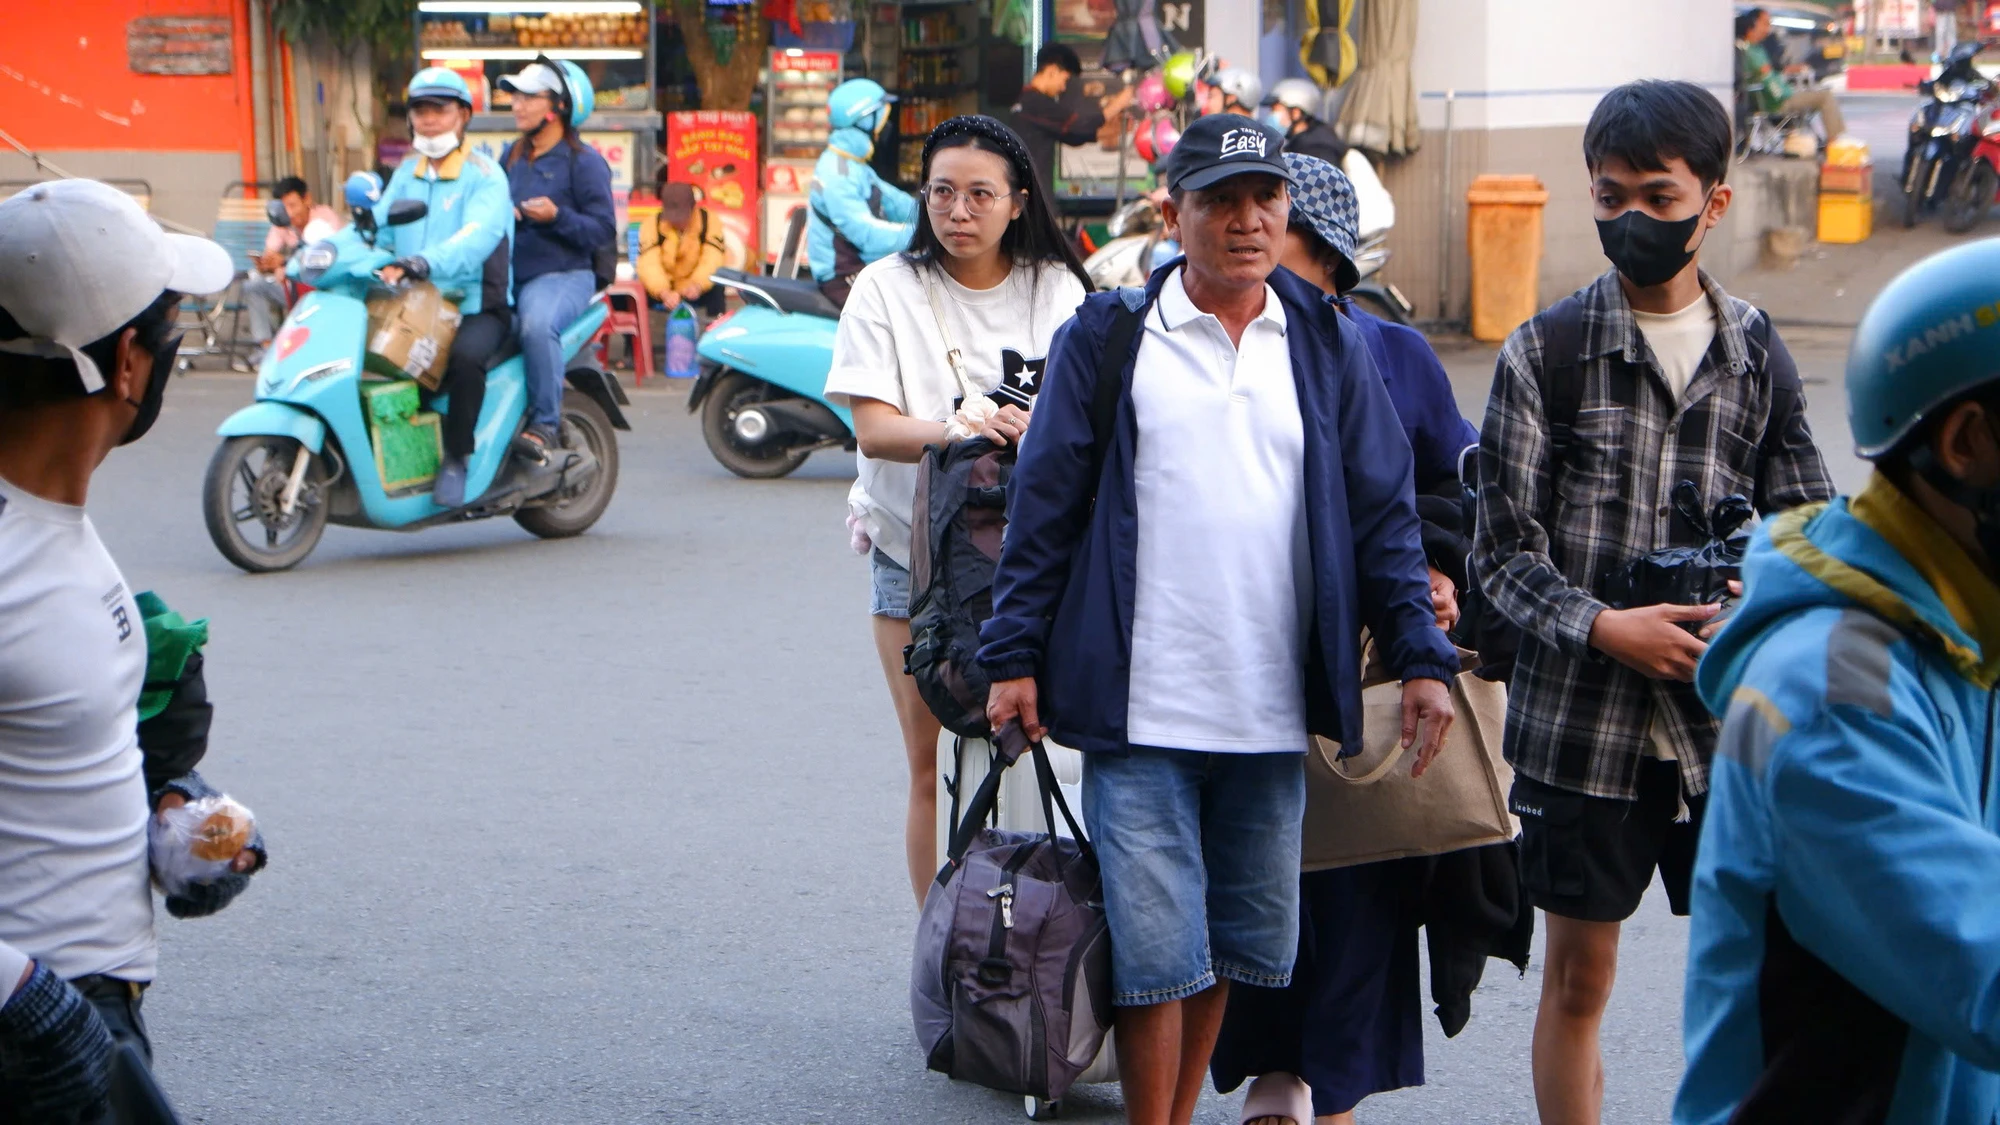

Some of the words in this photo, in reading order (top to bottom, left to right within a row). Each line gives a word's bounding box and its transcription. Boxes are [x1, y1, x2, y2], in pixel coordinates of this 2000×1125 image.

[1220, 129, 1267, 158] Easy
[1240, 127, 1257, 136] TAKE
[1884, 313, 1975, 375] XANH
